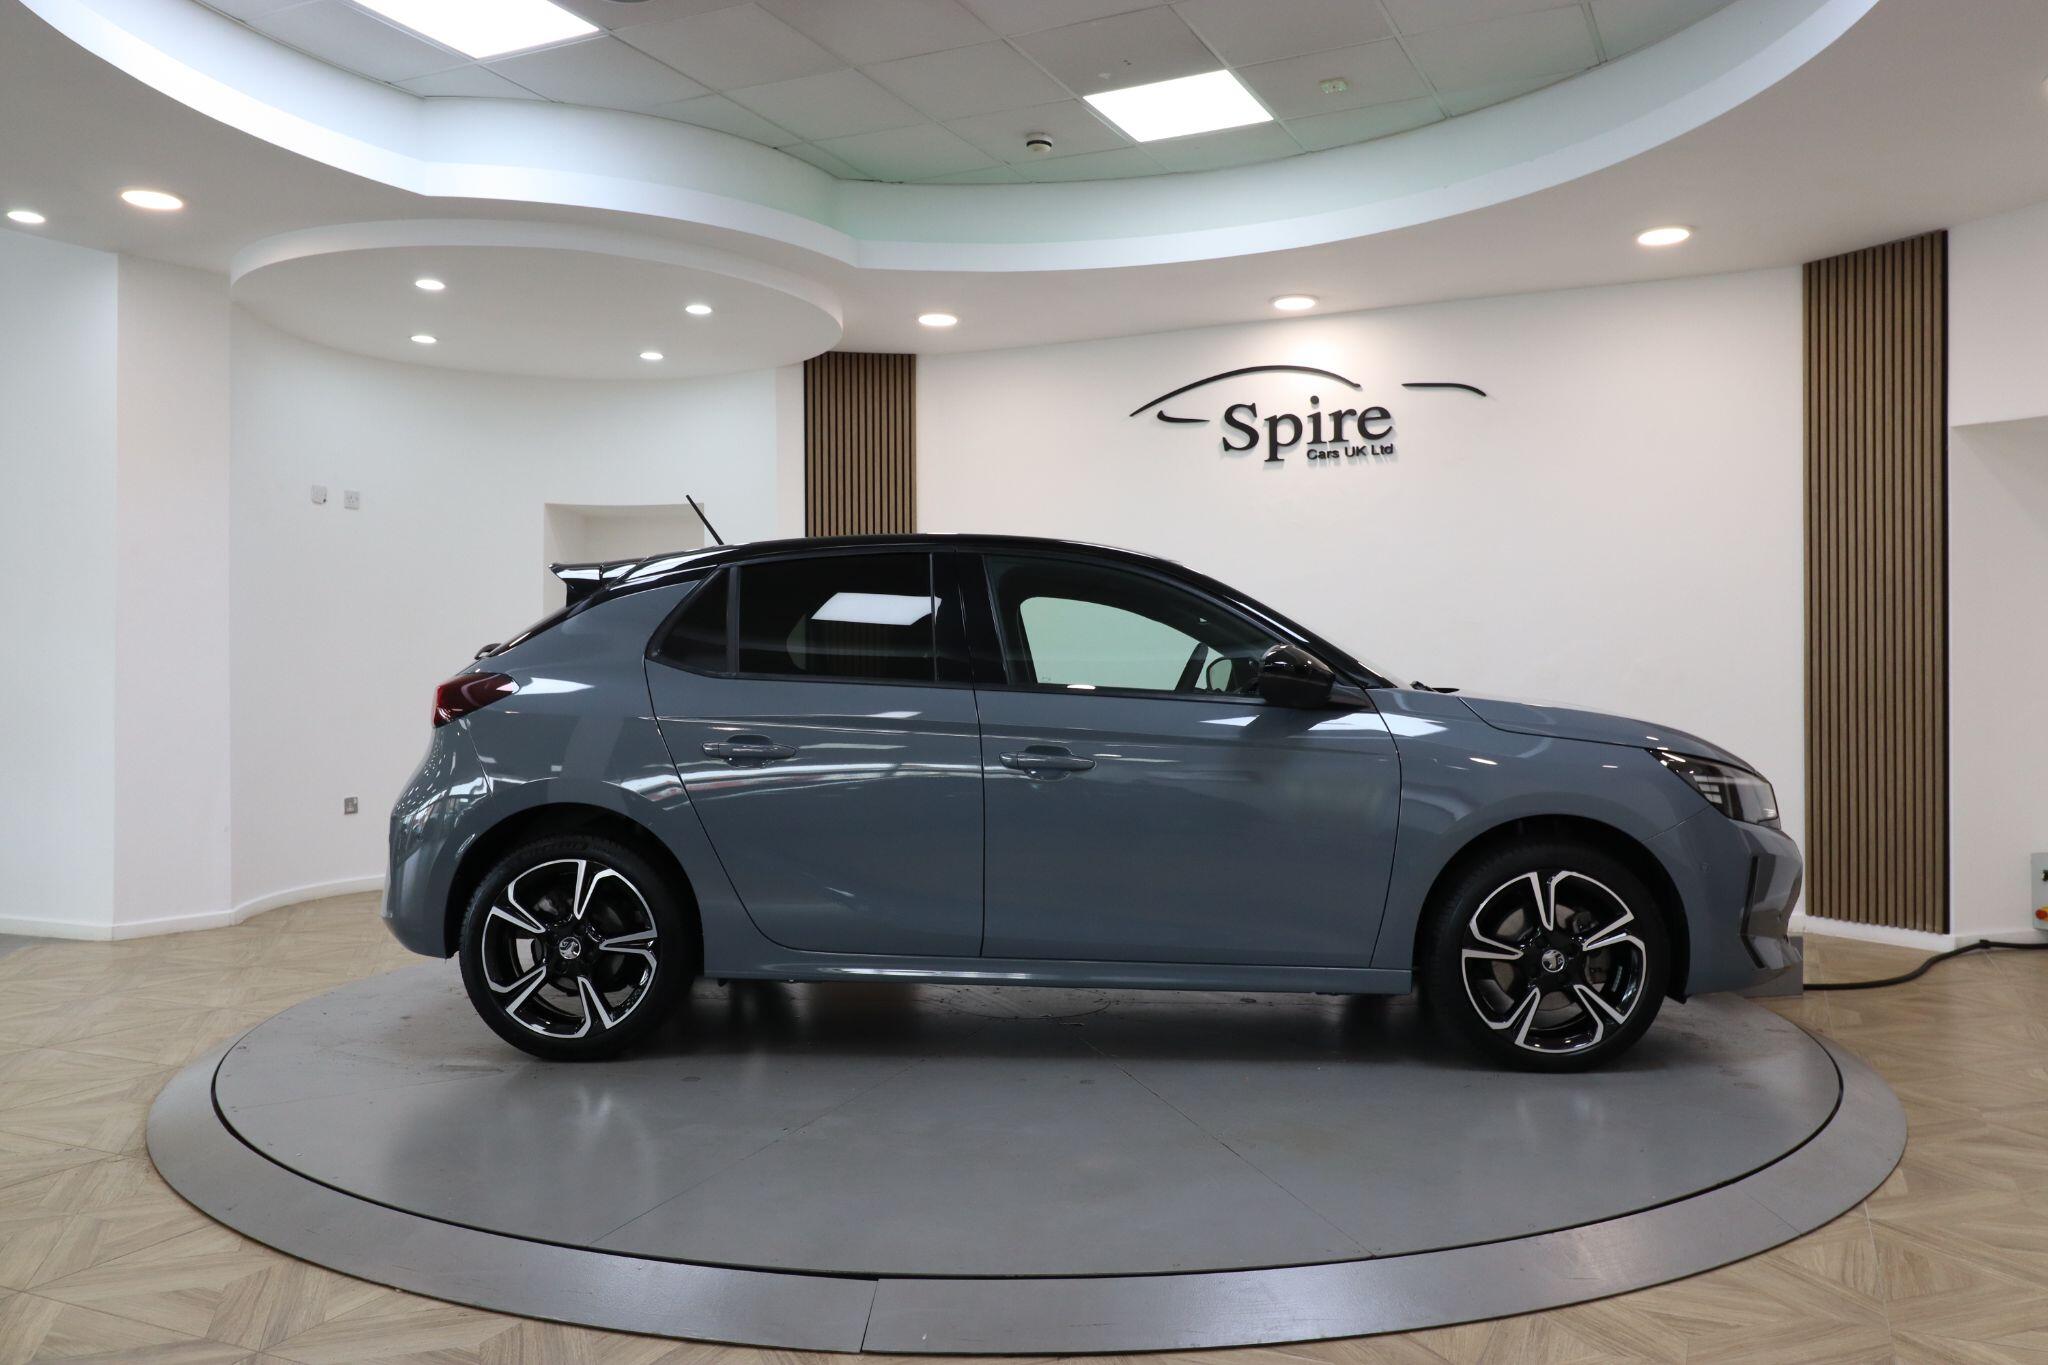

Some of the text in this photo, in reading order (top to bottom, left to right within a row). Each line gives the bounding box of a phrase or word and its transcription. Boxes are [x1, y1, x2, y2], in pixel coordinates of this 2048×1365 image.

[1222, 395, 1393, 462] Spire
[1307, 443, 1394, 460] Cars UK Ltd
